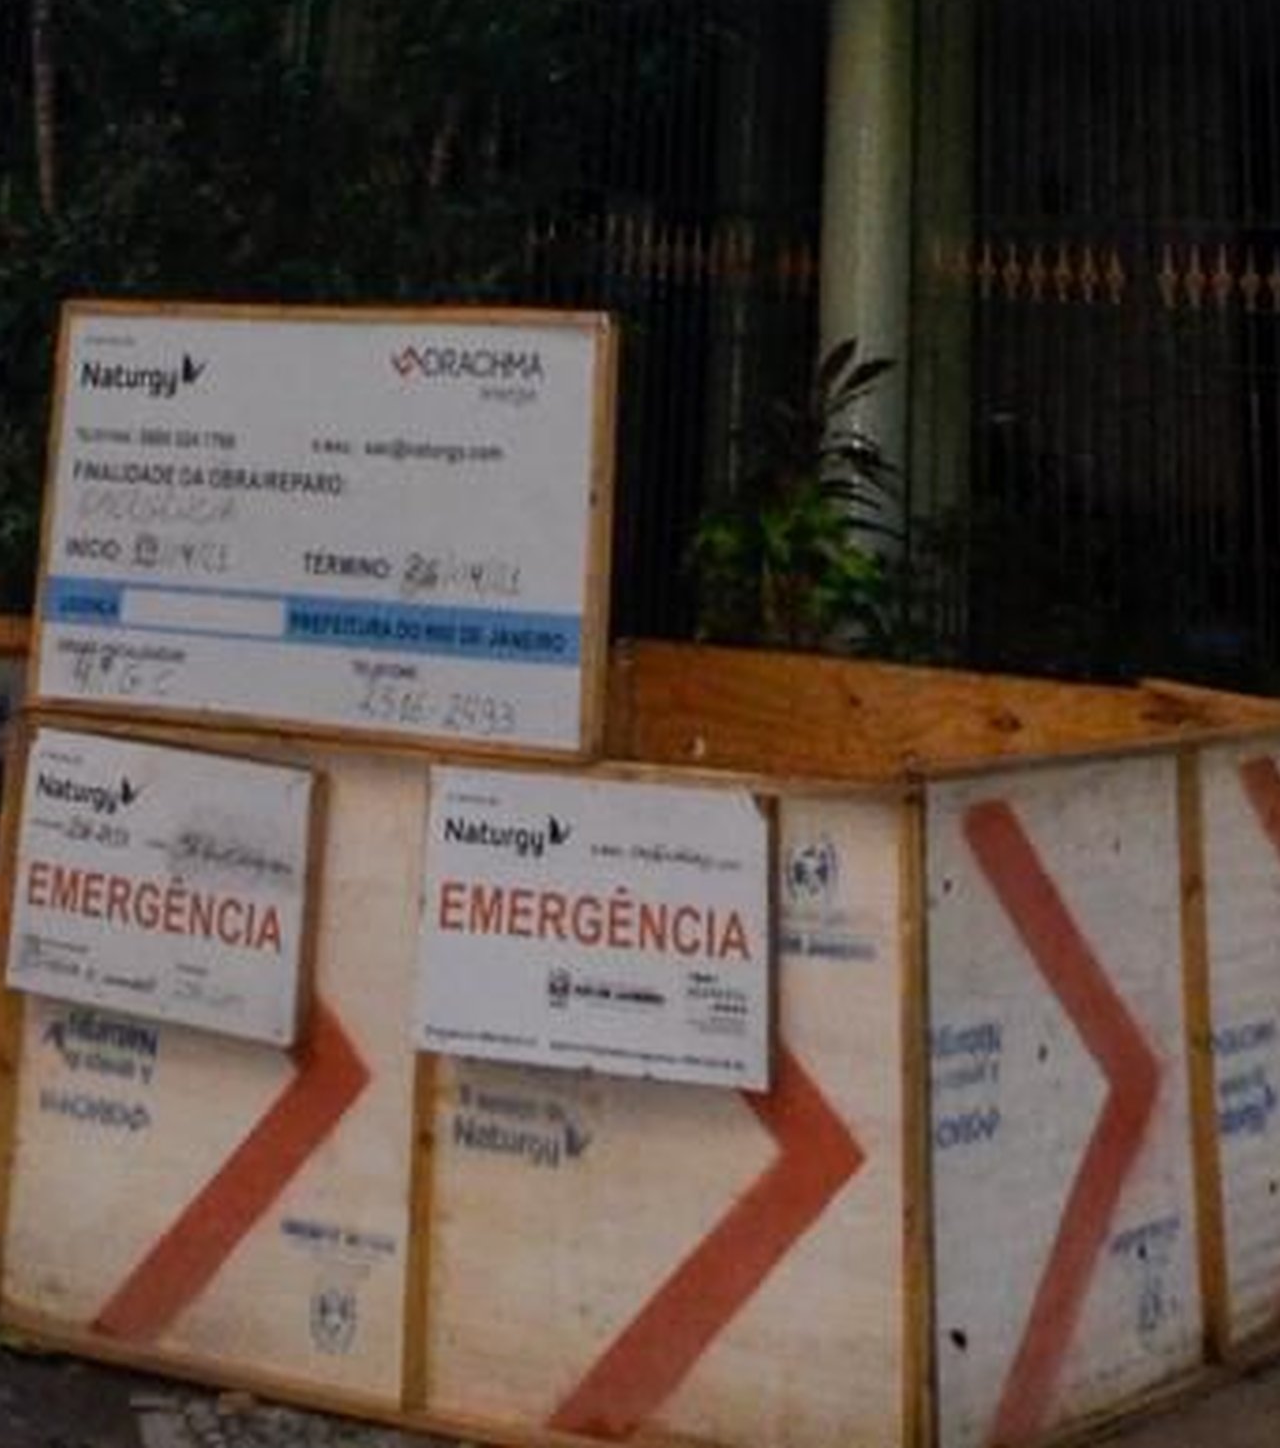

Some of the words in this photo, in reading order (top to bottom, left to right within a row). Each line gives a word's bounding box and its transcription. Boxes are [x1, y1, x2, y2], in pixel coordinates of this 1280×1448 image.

[80, 361, 177, 399] Naturgy
[37, 773, 118, 814] Naturgy
[444, 816, 545, 857] Naturgy
[27, 861, 283, 954] EMERGÊNCIA
[438, 880, 751, 960] EMERGÊNCIA
